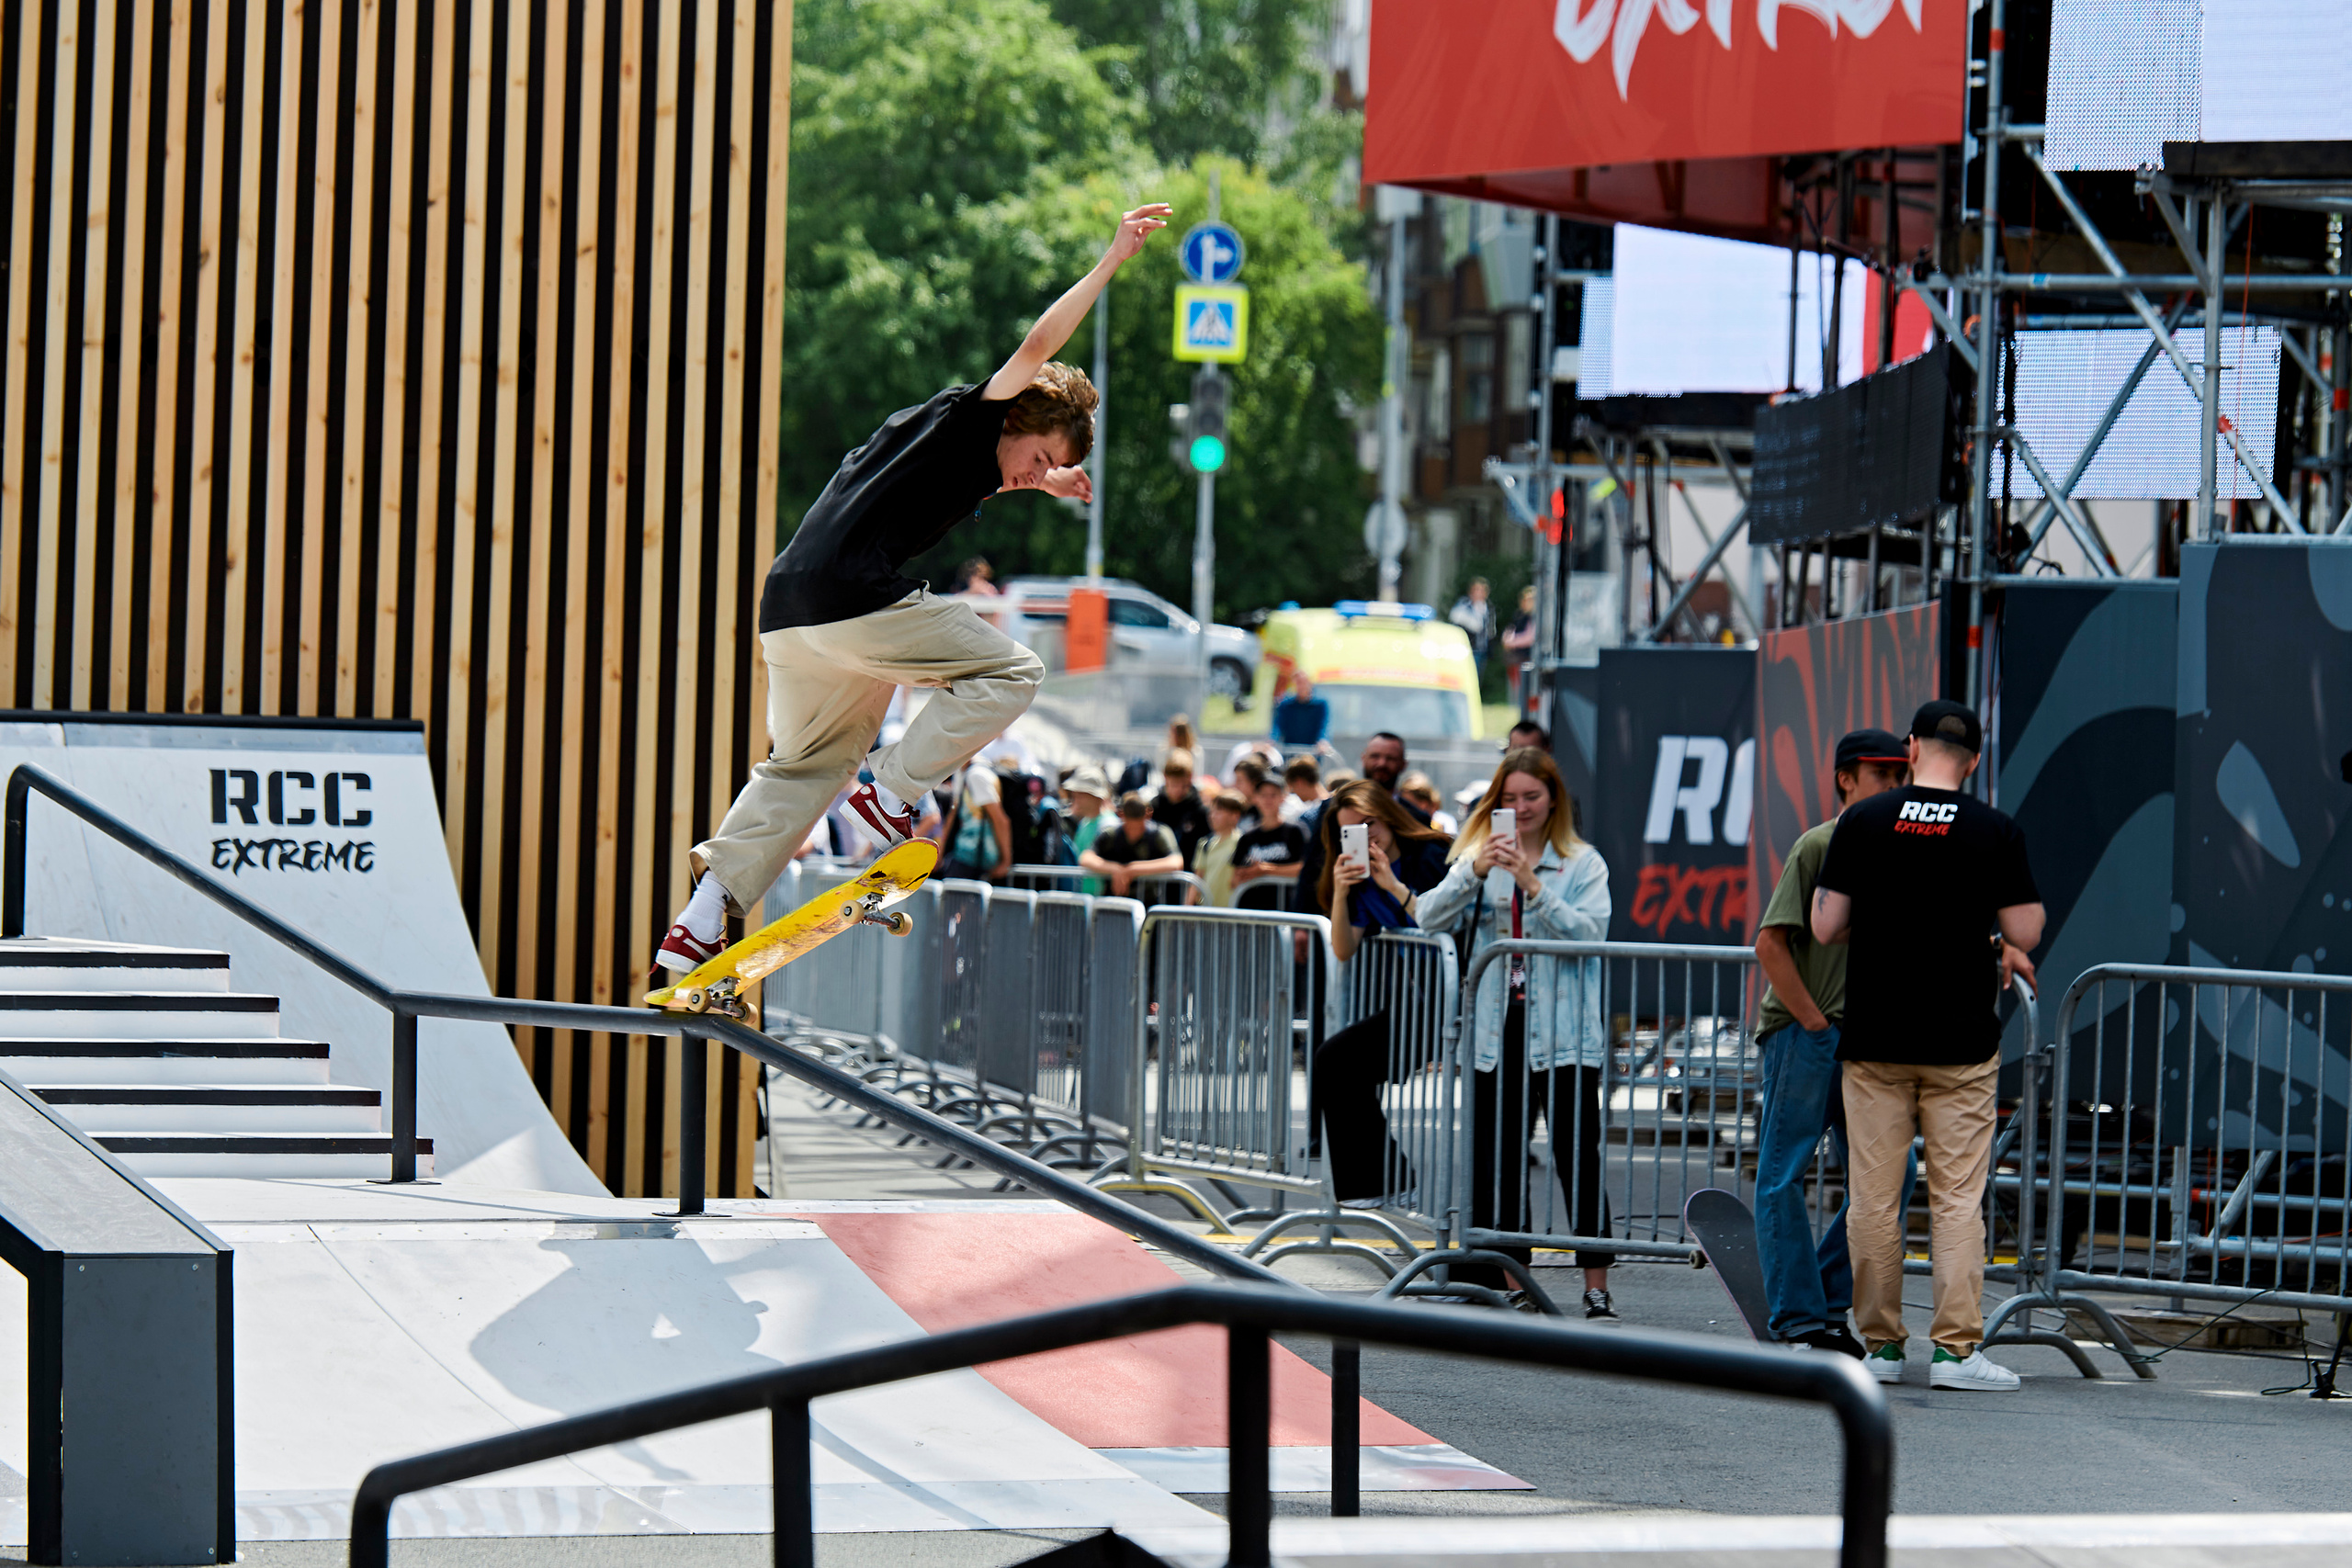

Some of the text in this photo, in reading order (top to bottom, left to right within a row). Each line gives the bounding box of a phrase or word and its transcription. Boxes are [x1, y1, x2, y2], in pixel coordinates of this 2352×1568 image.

[209, 768, 372, 827] RCC
[1899, 800, 1959, 823] RCC
[1894, 819, 1951, 837] EXTREME
[211, 838, 376, 877] EXTREME
